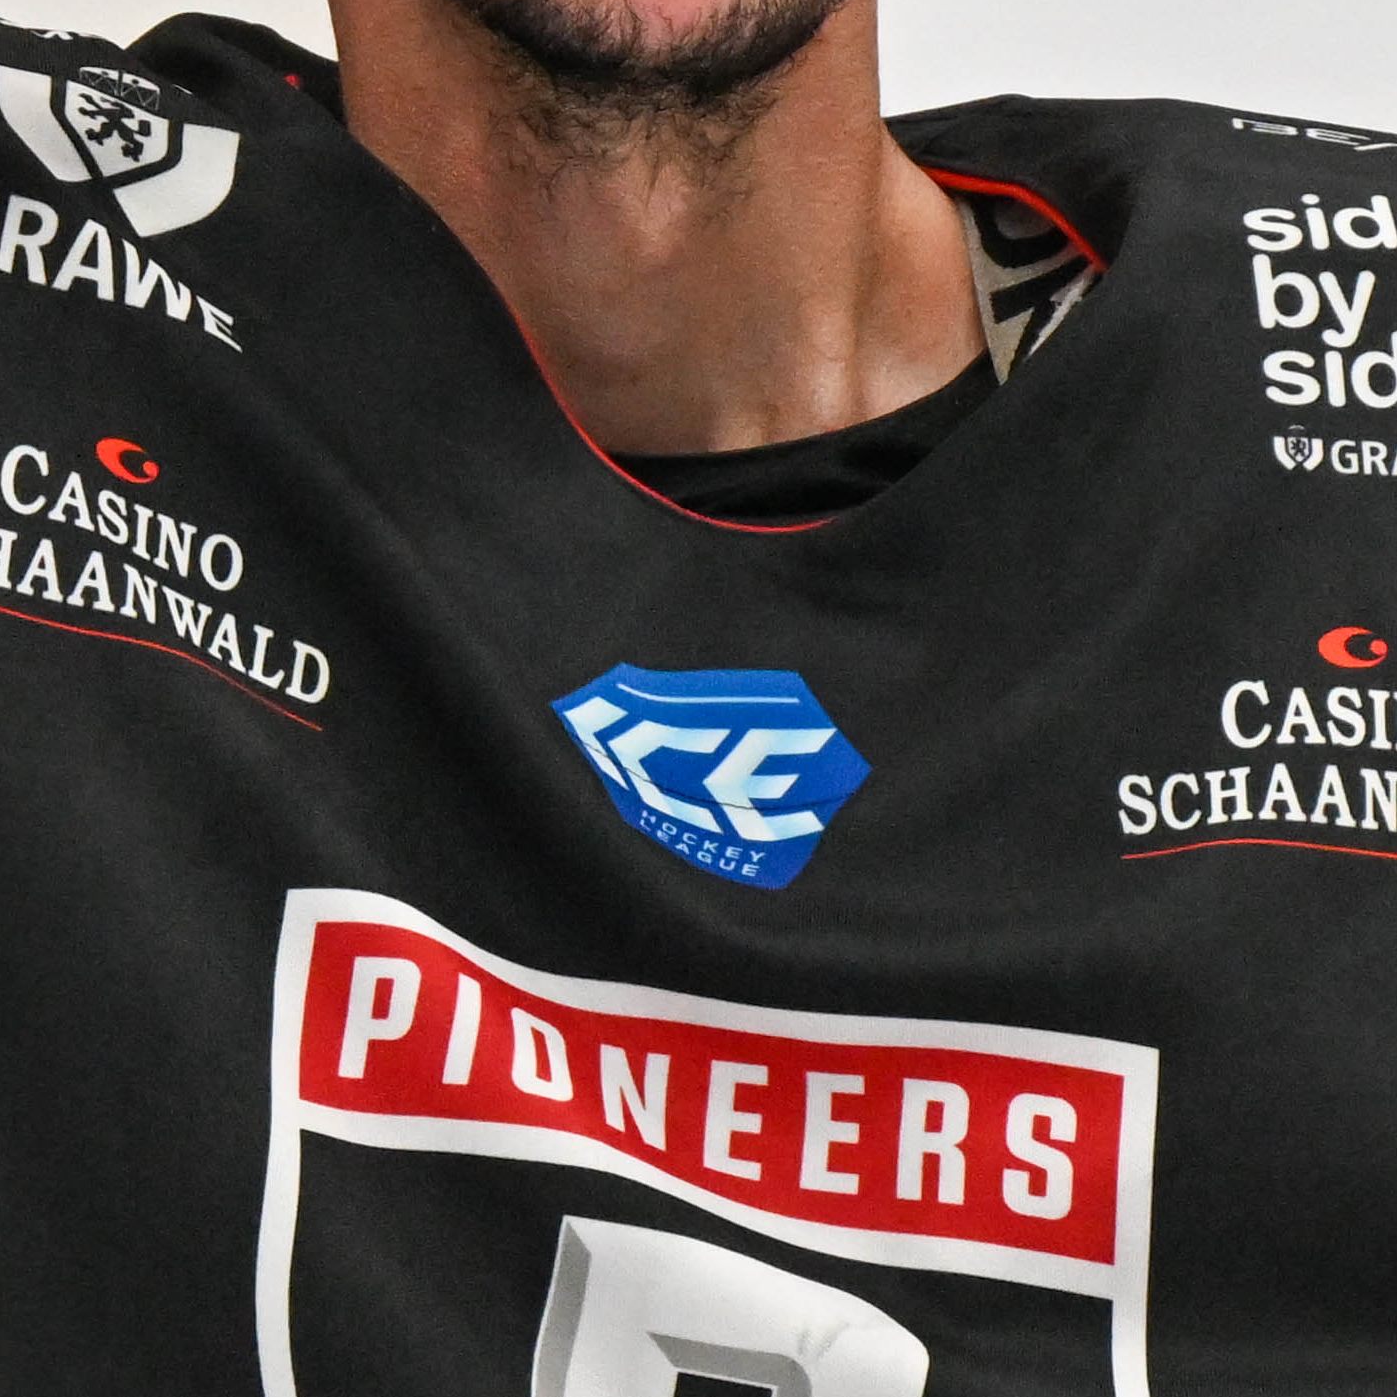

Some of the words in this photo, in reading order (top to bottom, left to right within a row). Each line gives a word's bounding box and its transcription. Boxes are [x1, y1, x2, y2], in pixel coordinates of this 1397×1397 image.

[1253, 253, 1375, 348] by
[0, 445, 244, 590] CASINO
[563, 696, 838, 841] ICE
[640, 819, 762, 877] LEAGUE
[641, 810, 766, 863] HOCKEY
[337, 956, 1078, 1220] PIONEERS
